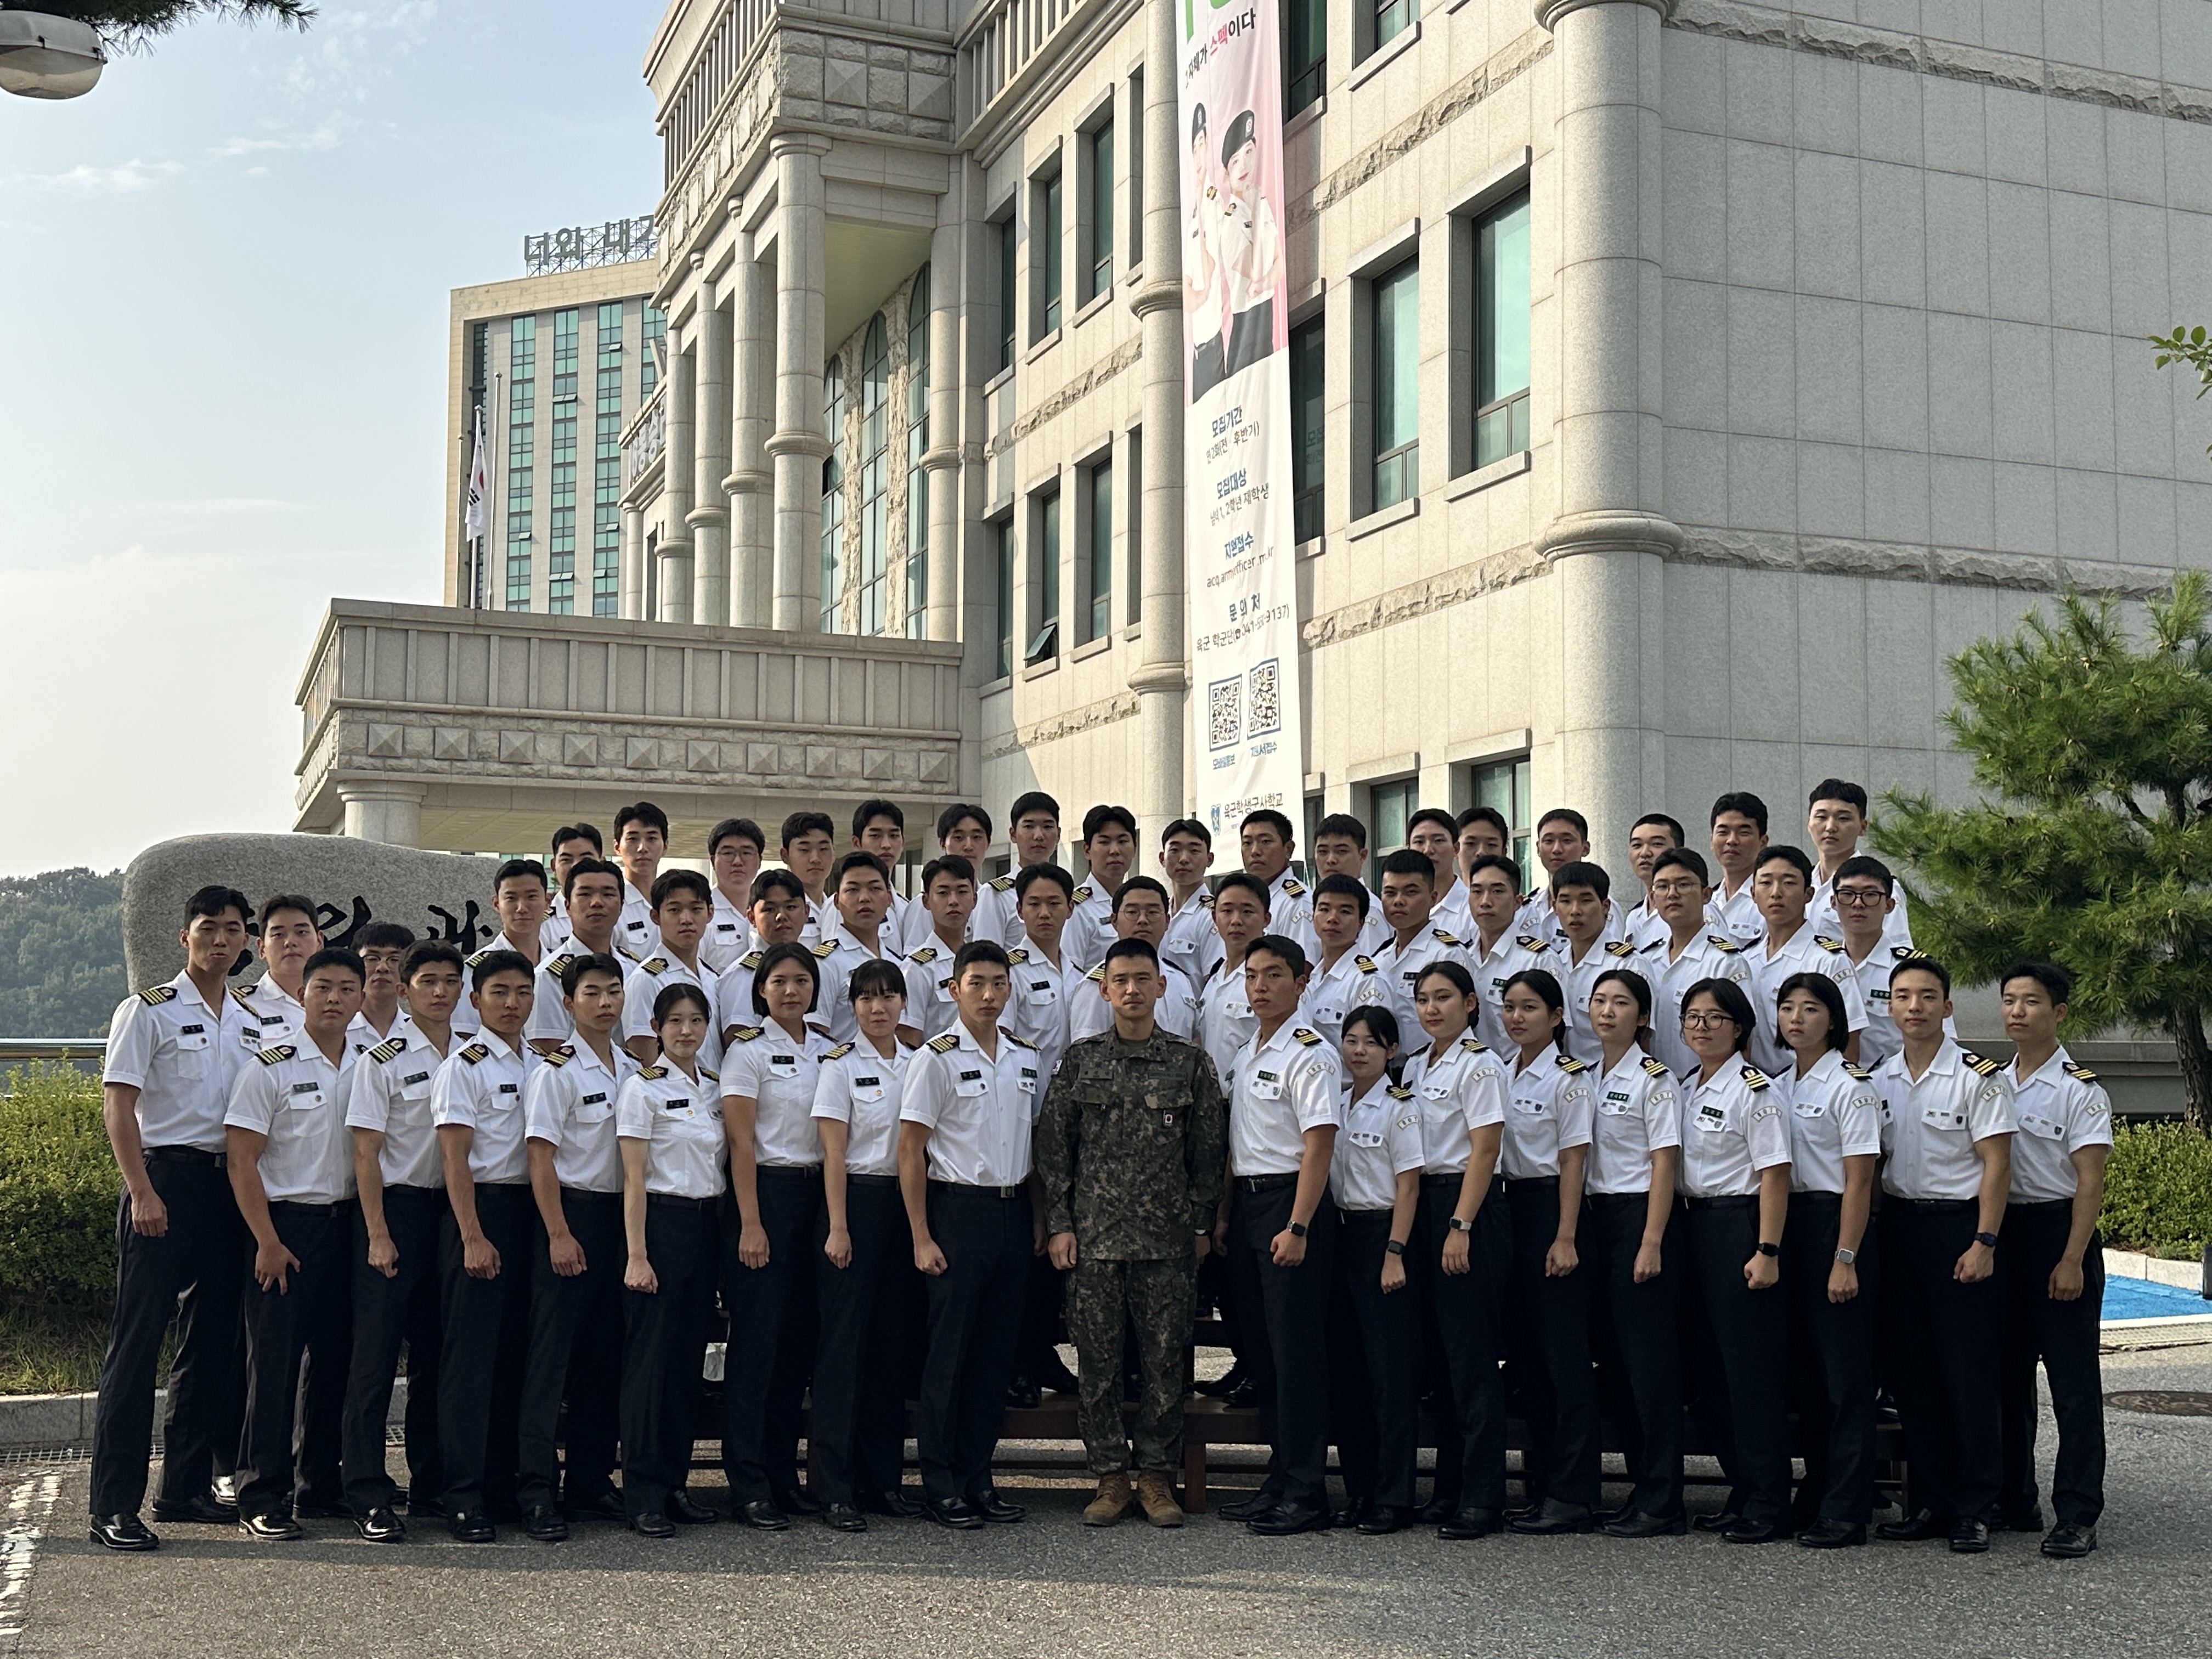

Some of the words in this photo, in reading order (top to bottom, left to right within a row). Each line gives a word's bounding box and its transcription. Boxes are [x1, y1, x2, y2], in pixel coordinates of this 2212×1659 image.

[1210, 8, 1256, 56] 스펙이다
[524, 227, 584, 266] 너와
[1212, 404, 1243, 438] 모집기간
[1217, 467, 1246, 500] 모집대상
[1243, 482, 1269, 505] 재학생
[1224, 531, 1254, 560] 지원접수
[1197, 636, 1210, 653] 육군
[1223, 793, 1283, 819] 육군학생군사학교
